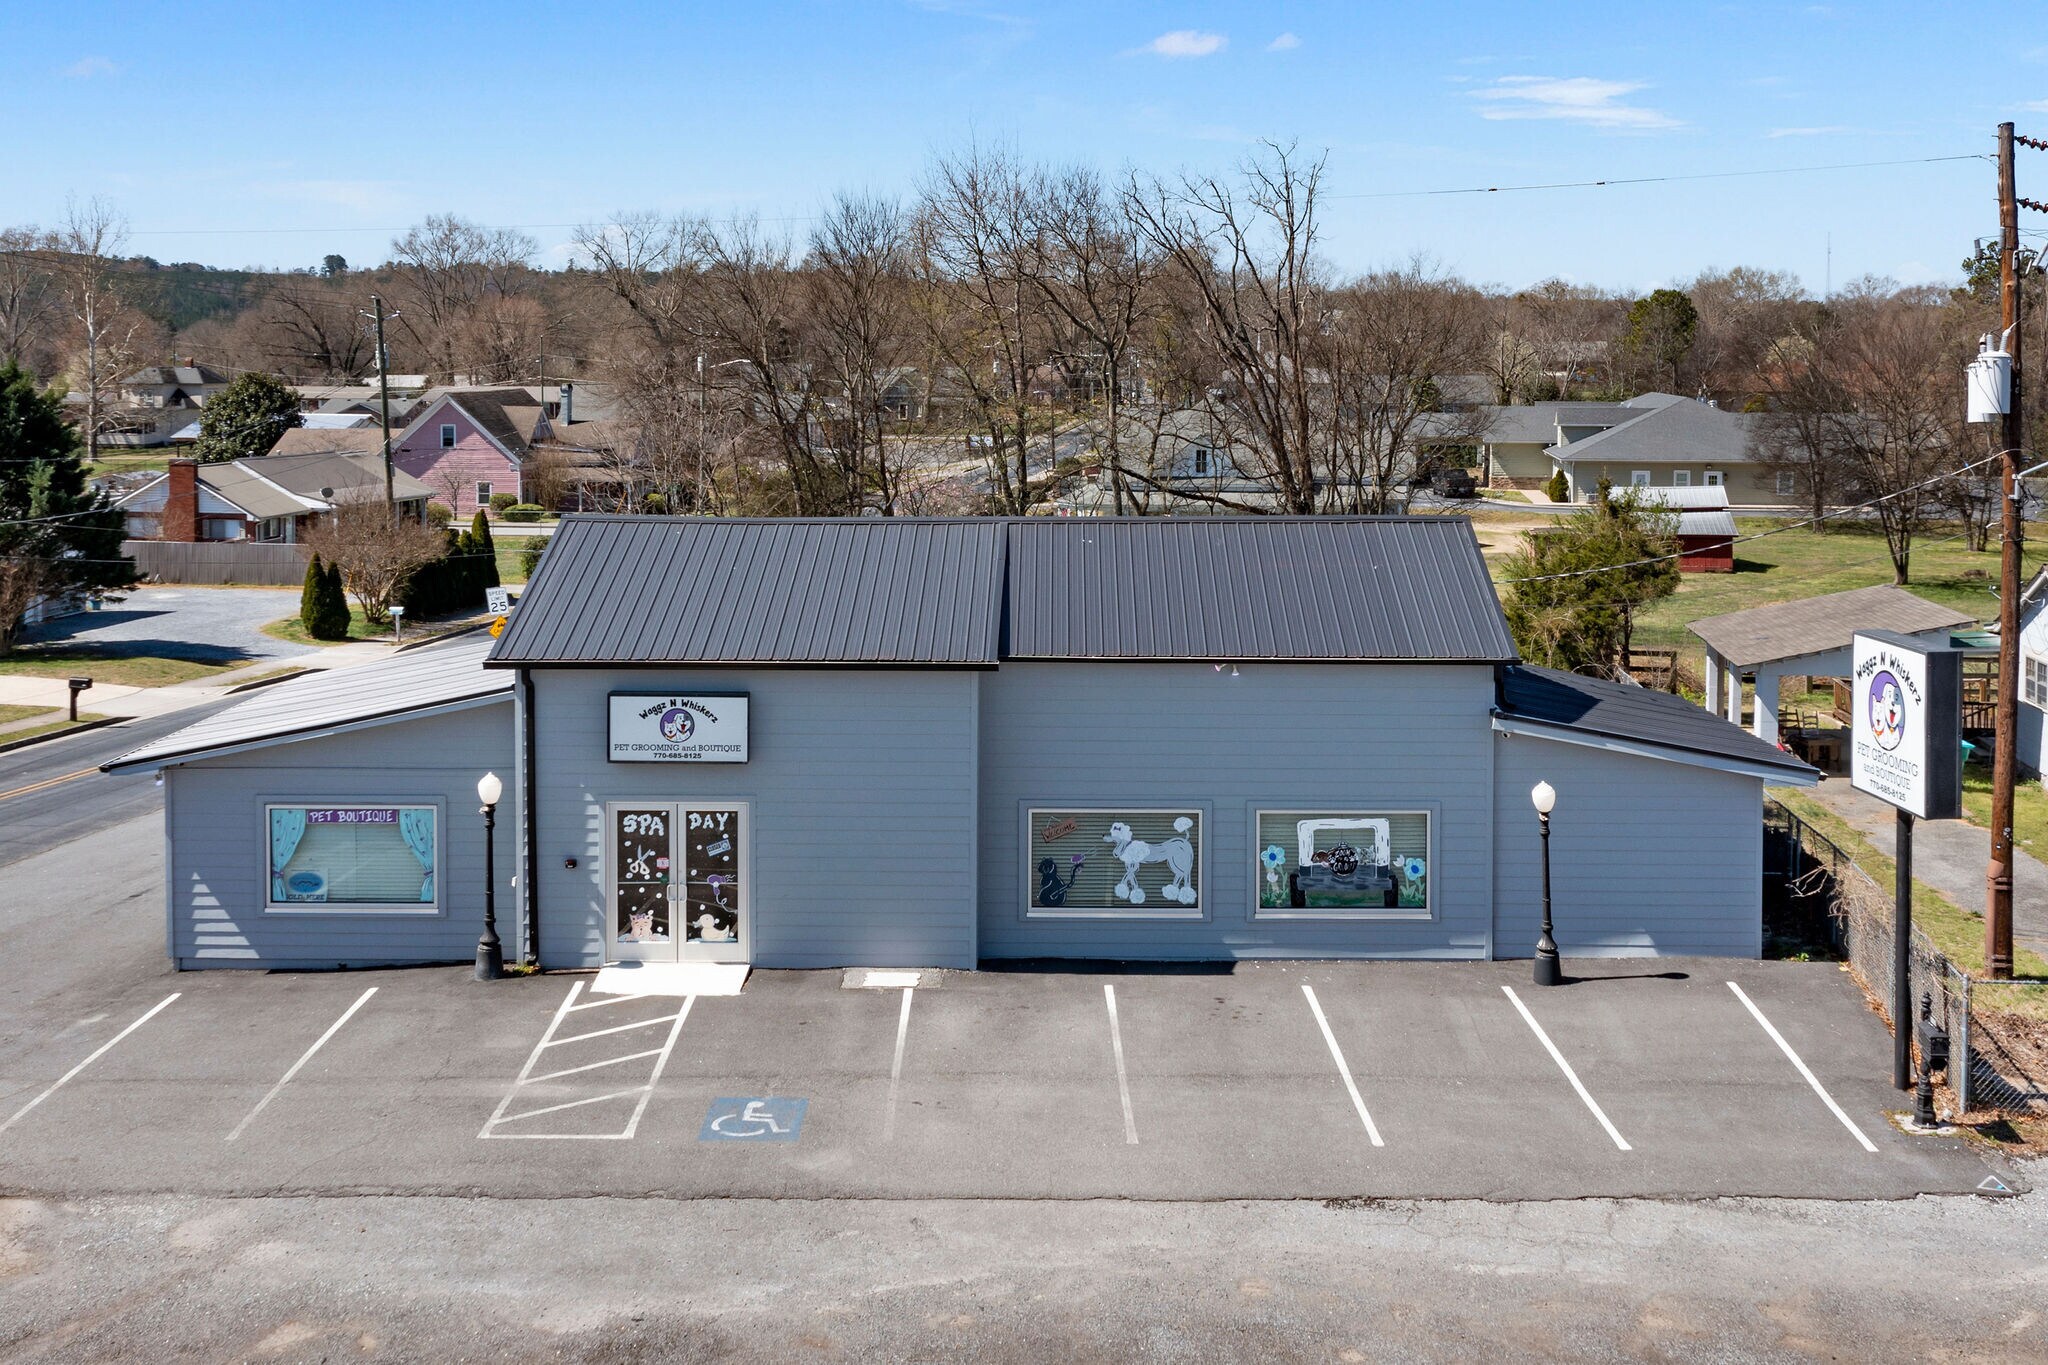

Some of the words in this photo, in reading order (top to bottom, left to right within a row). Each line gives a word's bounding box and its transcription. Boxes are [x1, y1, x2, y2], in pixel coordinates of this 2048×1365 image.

[491, 601, 507, 612] 25
[1856, 656, 1877, 680] Waggz
[1880, 651, 1886, 665] N
[1889, 653, 1922, 706] Whiskerz
[638, 701, 667, 720] Waggz
[670, 699, 676, 707] N
[681, 699, 718, 723] Whiskerz
[698, 744, 742, 752] BOUTIQUE
[1857, 741, 1871, 758] PET
[1872, 747, 1918, 777] GROOMING
[1863, 763, 1874, 776] and
[1875, 765, 1911, 791] BOUTIQUE
[1869, 778, 1906, 803] 770-685-8125
[310, 810, 333, 821] PET
[337, 810, 393, 822] BOUTIQUE
[623, 813, 664, 836] SPA
[688, 812, 729, 831] DAY
